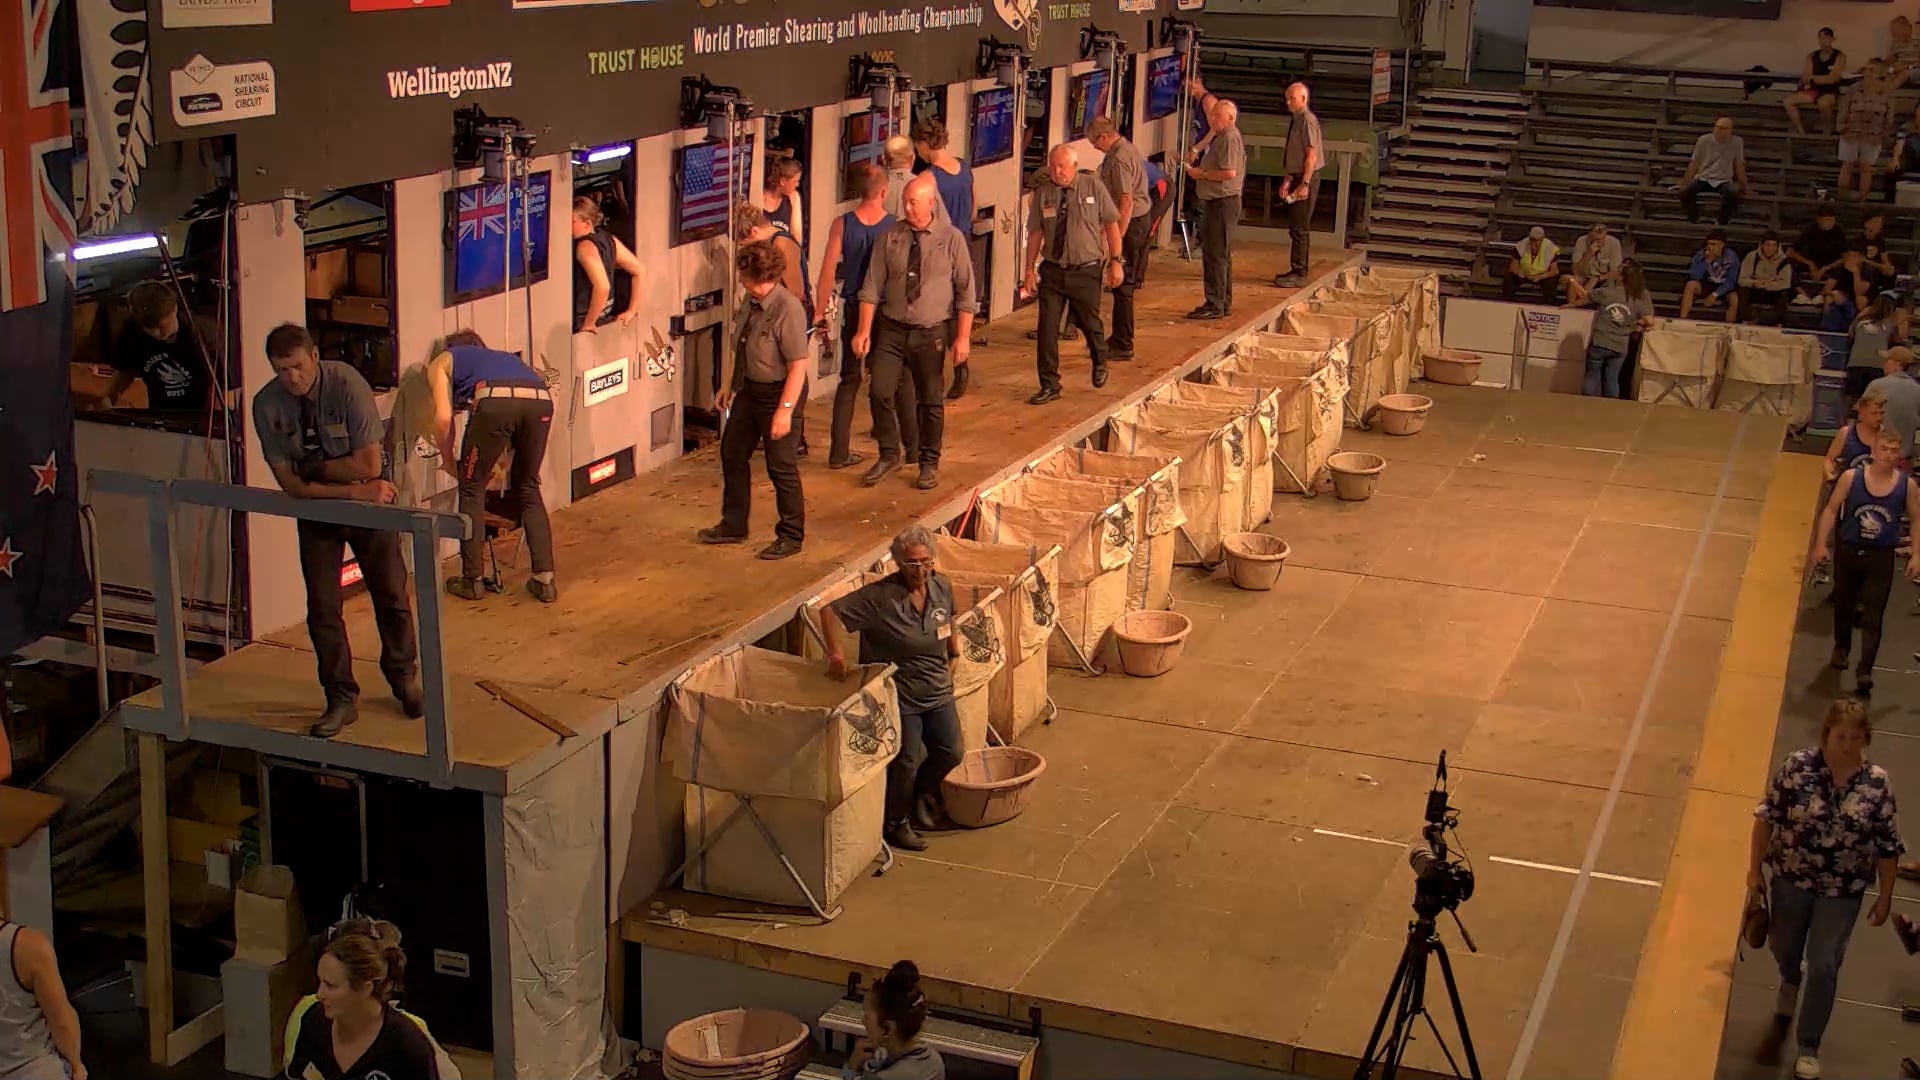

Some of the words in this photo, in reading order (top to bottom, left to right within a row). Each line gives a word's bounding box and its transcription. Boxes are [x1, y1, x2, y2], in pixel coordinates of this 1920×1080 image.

[1049, 4, 1070, 20] TRUST
[693, 25, 731, 54] World
[736, 22, 781, 50] Premier
[785, 17, 834, 44] Shearing
[836, 13, 855, 39] and
[858, 8, 921, 34] Woolhandling
[923, 2, 982, 30] Championship
[588, 48, 635, 75] TRUST
[640, 44, 685, 70] HOUSE
[234, 72, 269, 84] NATIONAL
[387, 61, 513, 99] WellingtonNZ
[234, 84, 270, 97] SHEARING
[235, 97, 263, 109] CIRCUIT
[590, 371, 622, 393] BAYLEYS
